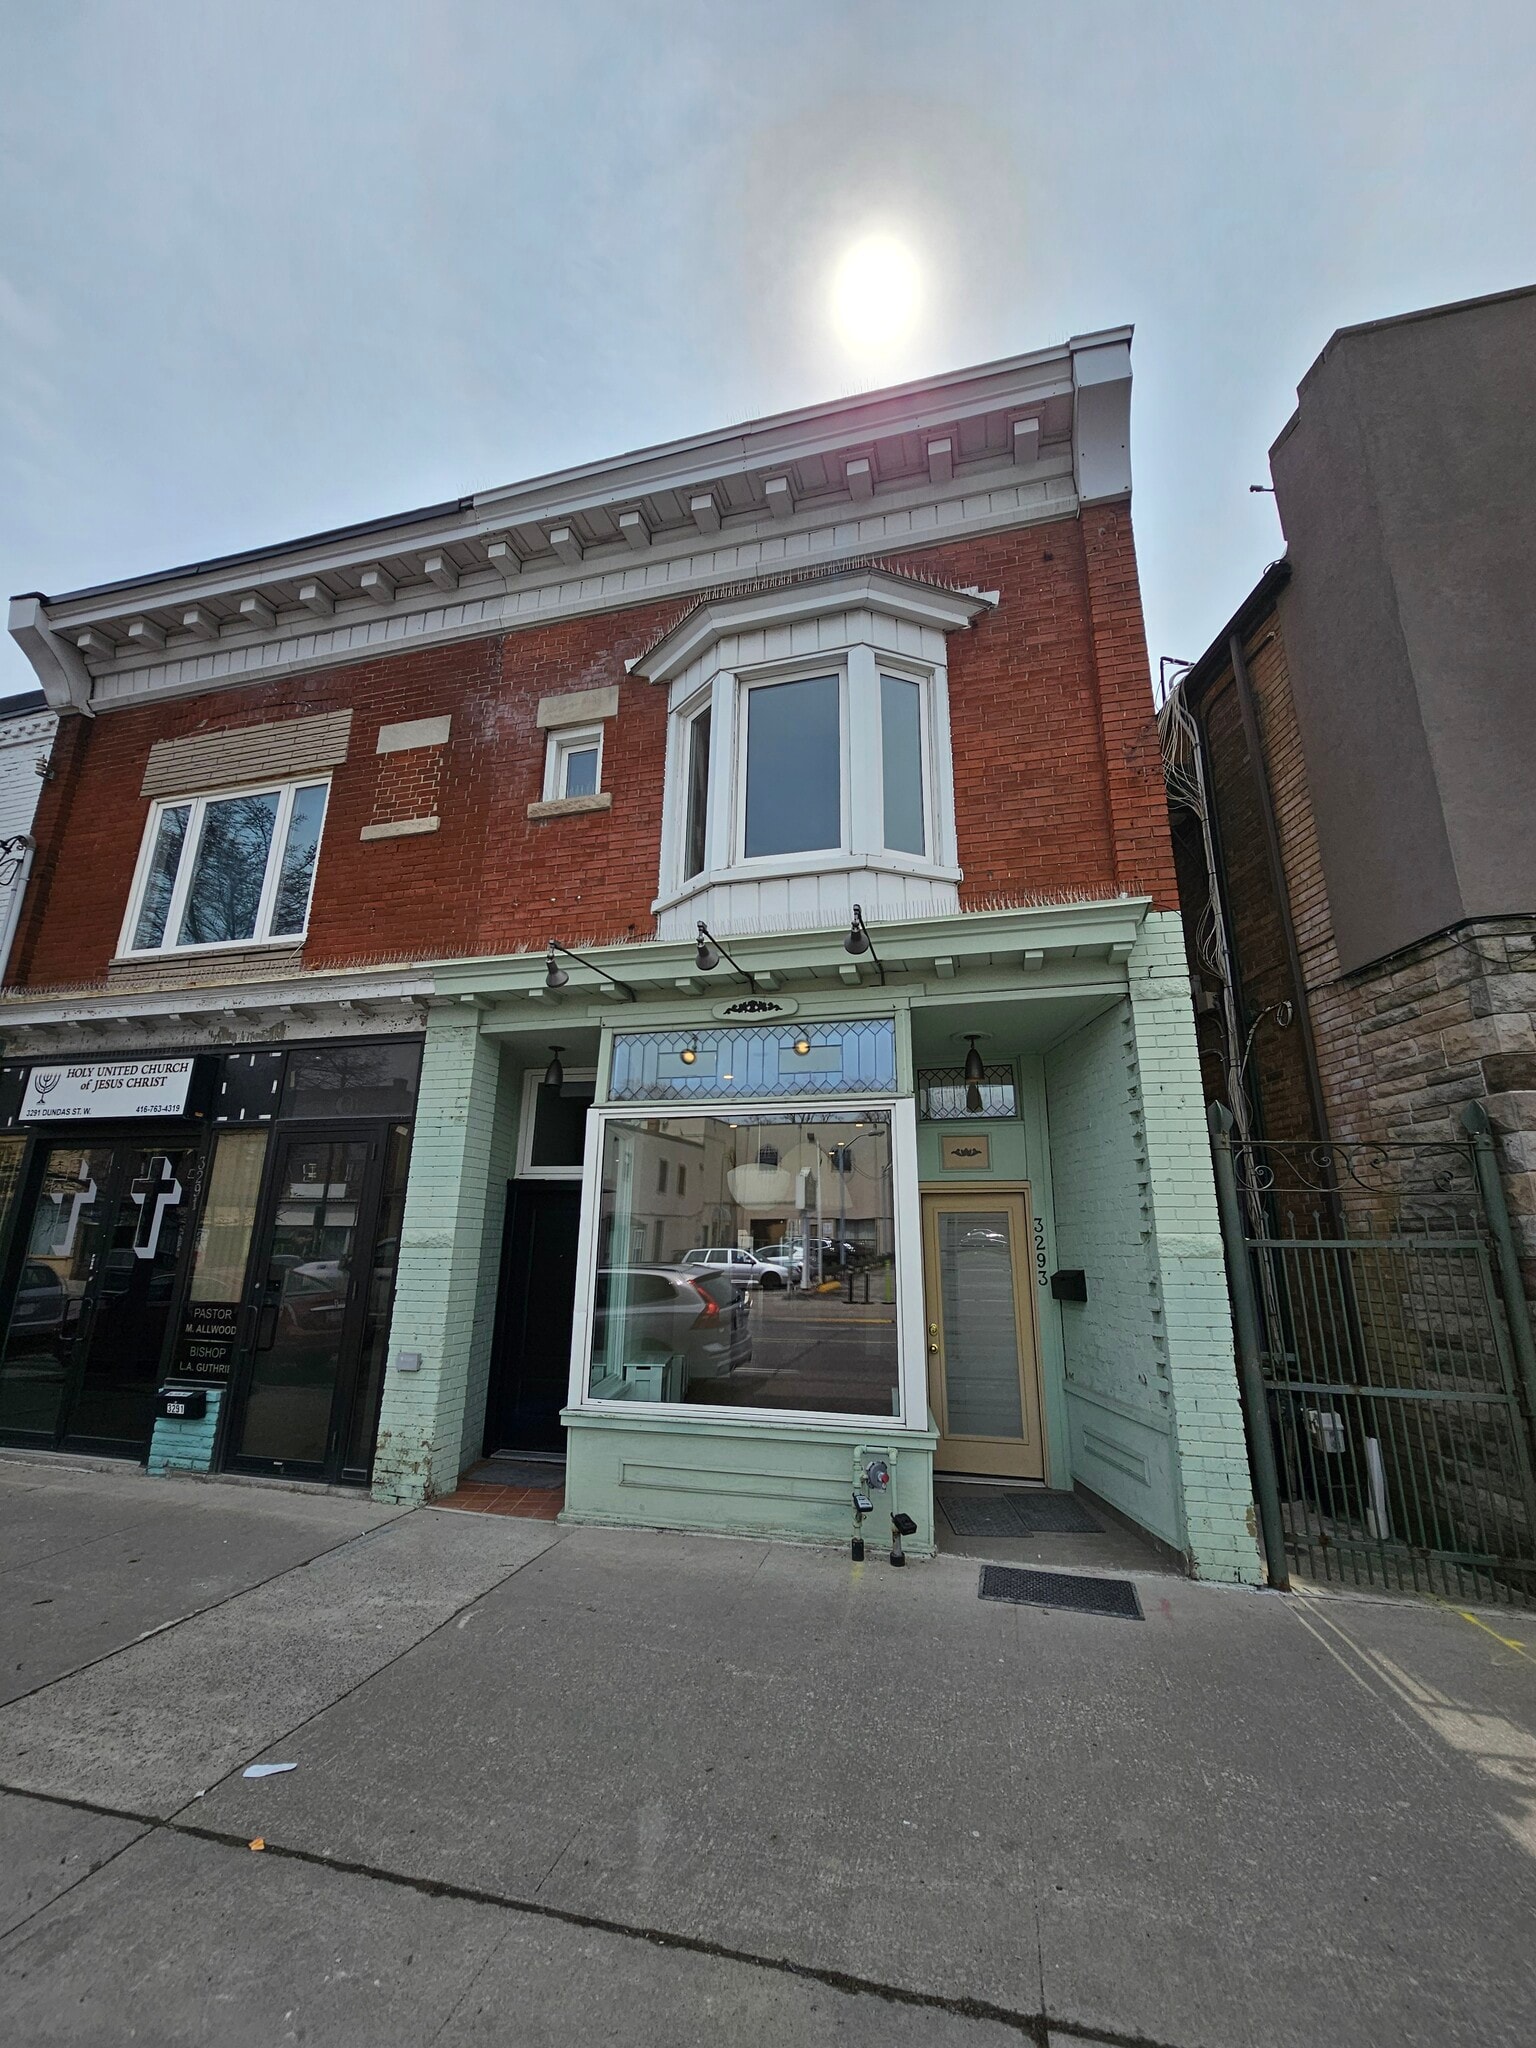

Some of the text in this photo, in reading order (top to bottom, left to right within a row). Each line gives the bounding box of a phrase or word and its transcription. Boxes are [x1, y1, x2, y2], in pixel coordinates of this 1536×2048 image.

[66, 1062, 189, 1078] HOLY UNITED CHURCH
[80, 1076, 167, 1092] of JESUS CHRIST
[26, 1107, 92, 1116] 3291 DUNDAS ST. W.
[136, 1104, 180, 1113] 416-763-4319
[1033, 1217, 1048, 1286] 3293
[194, 1308, 232, 1319] PASTOR
[185, 1324, 236, 1335] M. ALLWOOD
[189, 1346, 226, 1358] BISHOP
[179, 1361, 193, 1371] L.A.
[167, 1403, 183, 1413] 3291
